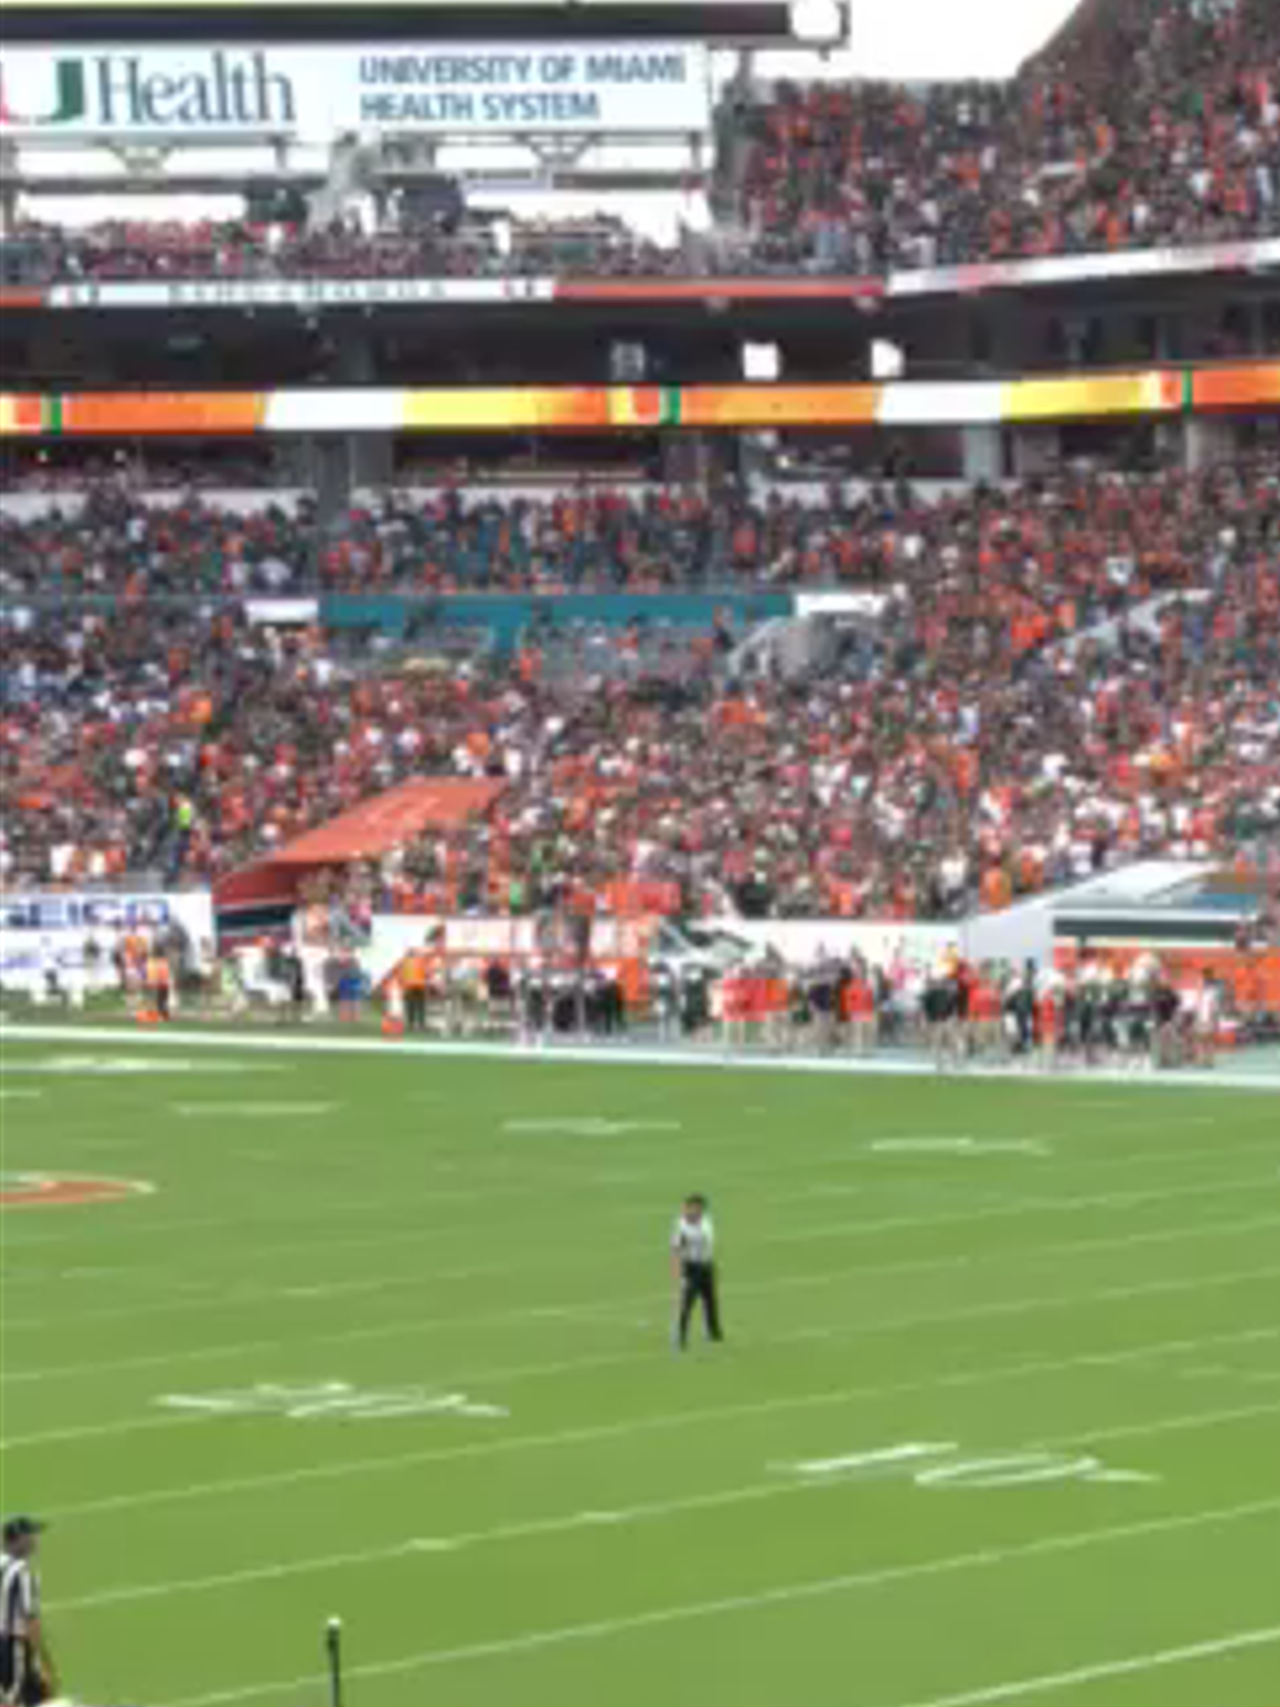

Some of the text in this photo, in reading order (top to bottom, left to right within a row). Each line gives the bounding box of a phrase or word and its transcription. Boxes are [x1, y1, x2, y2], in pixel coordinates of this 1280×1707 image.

[360, 54, 686, 83] UNIVERSITY OF MIAMI
[360, 92, 600, 121] HEALTH SYSTEM
